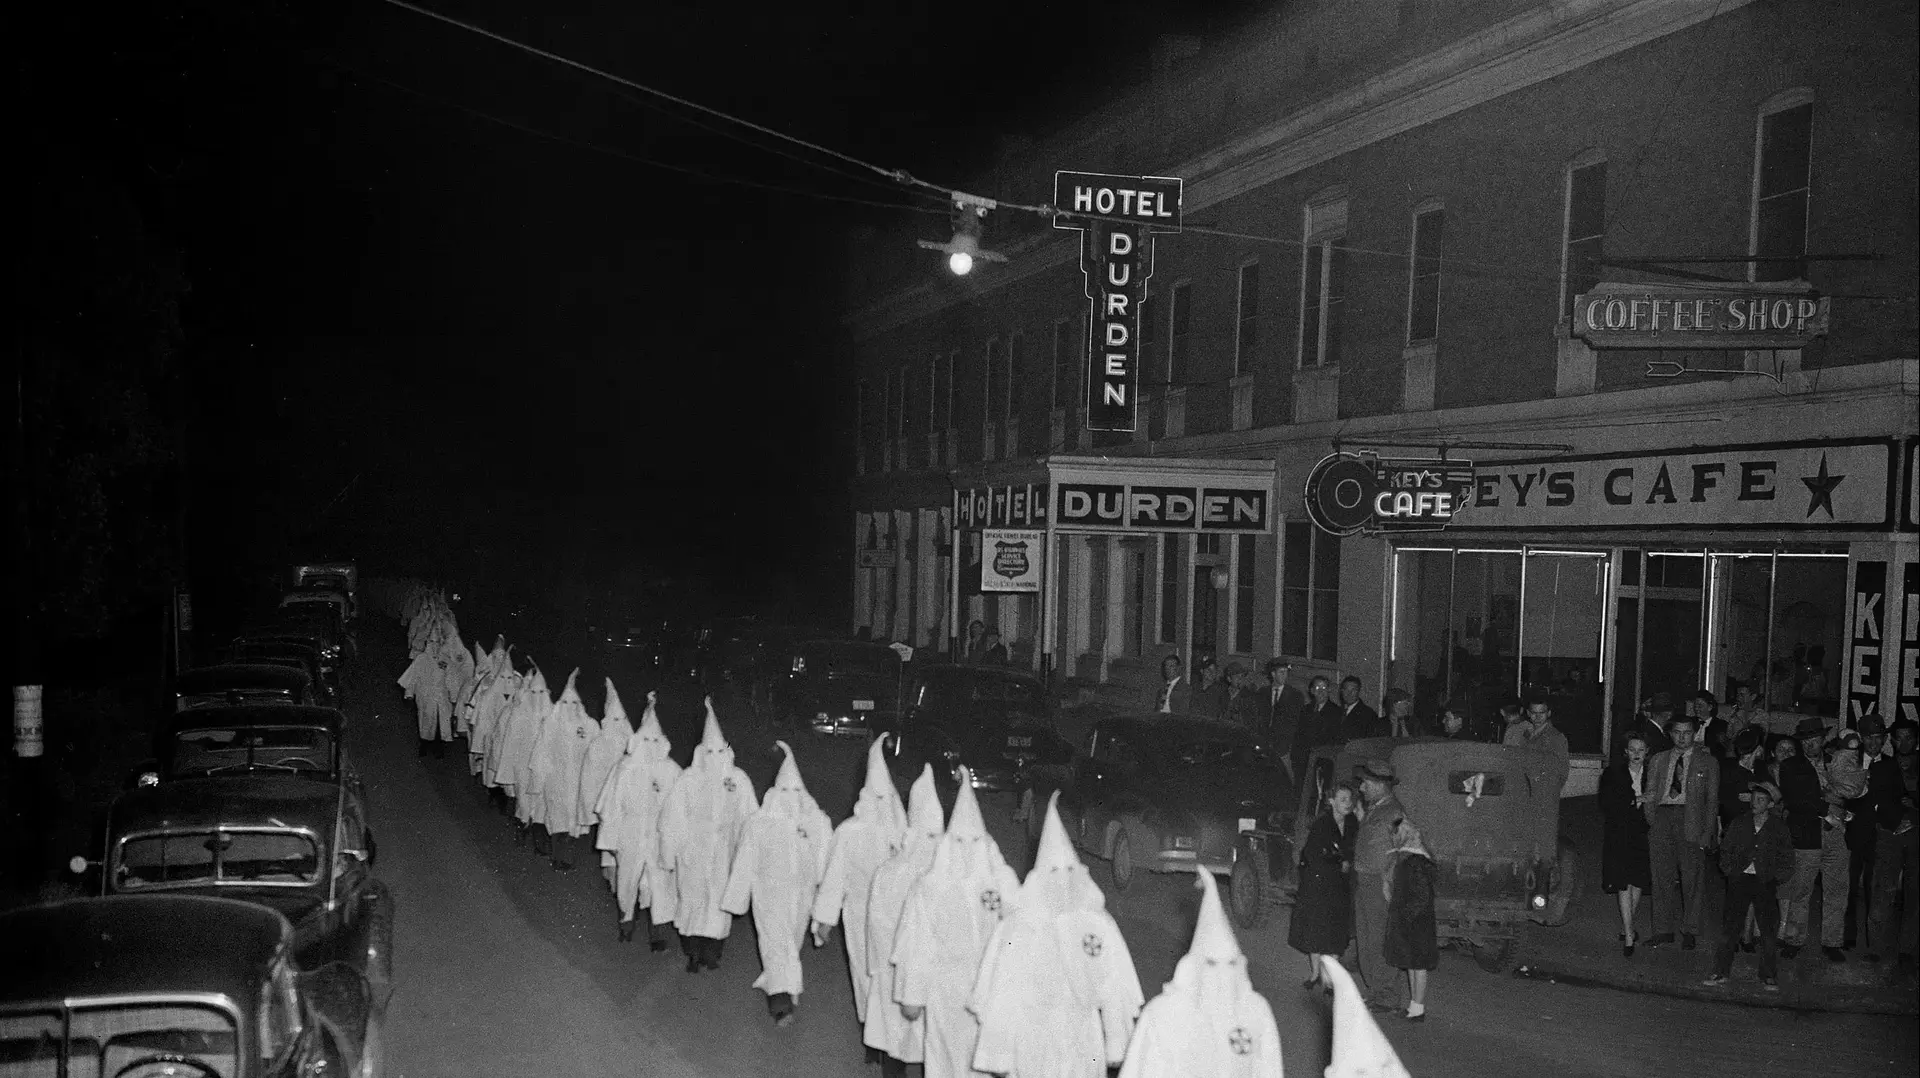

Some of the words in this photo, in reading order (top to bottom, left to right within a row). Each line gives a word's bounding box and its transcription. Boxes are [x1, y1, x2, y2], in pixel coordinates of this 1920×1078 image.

[1074, 186, 1172, 218] HOTEL
[1103, 232, 1133, 407] DURDEN
[1587, 298, 1714, 331] COFFEE
[1727, 298, 1817, 331] SHOP
[1390, 470, 1443, 488] KEY'S
[1463, 467, 1575, 507] EY'S
[1603, 460, 1777, 505] CAFE
[961, 490, 1045, 520] HOTEL
[1064, 490, 1260, 523] DURDEN
[1374, 491, 1452, 517] CAFE
